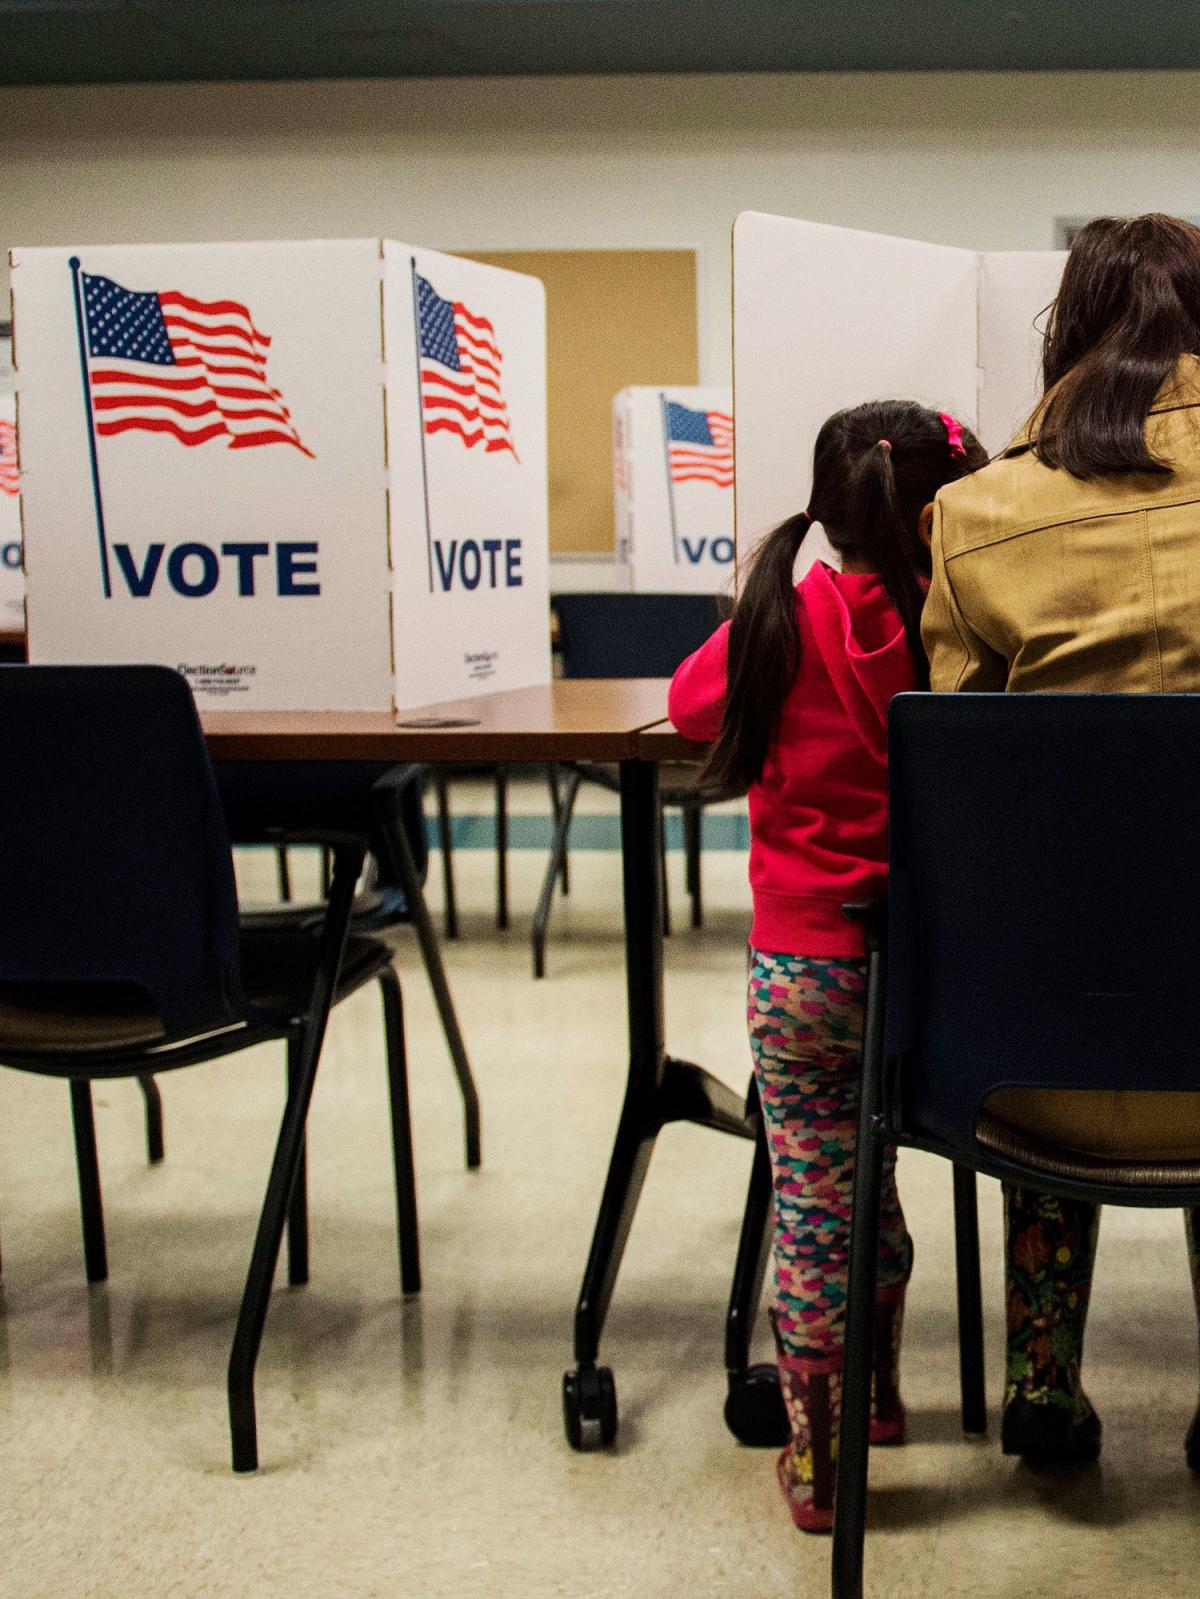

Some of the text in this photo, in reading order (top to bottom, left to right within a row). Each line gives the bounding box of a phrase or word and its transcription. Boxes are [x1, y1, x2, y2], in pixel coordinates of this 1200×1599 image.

[112, 541, 321, 598] VOTE
[433, 538, 523, 592] VOTE
[681, 536, 735, 565] VO
